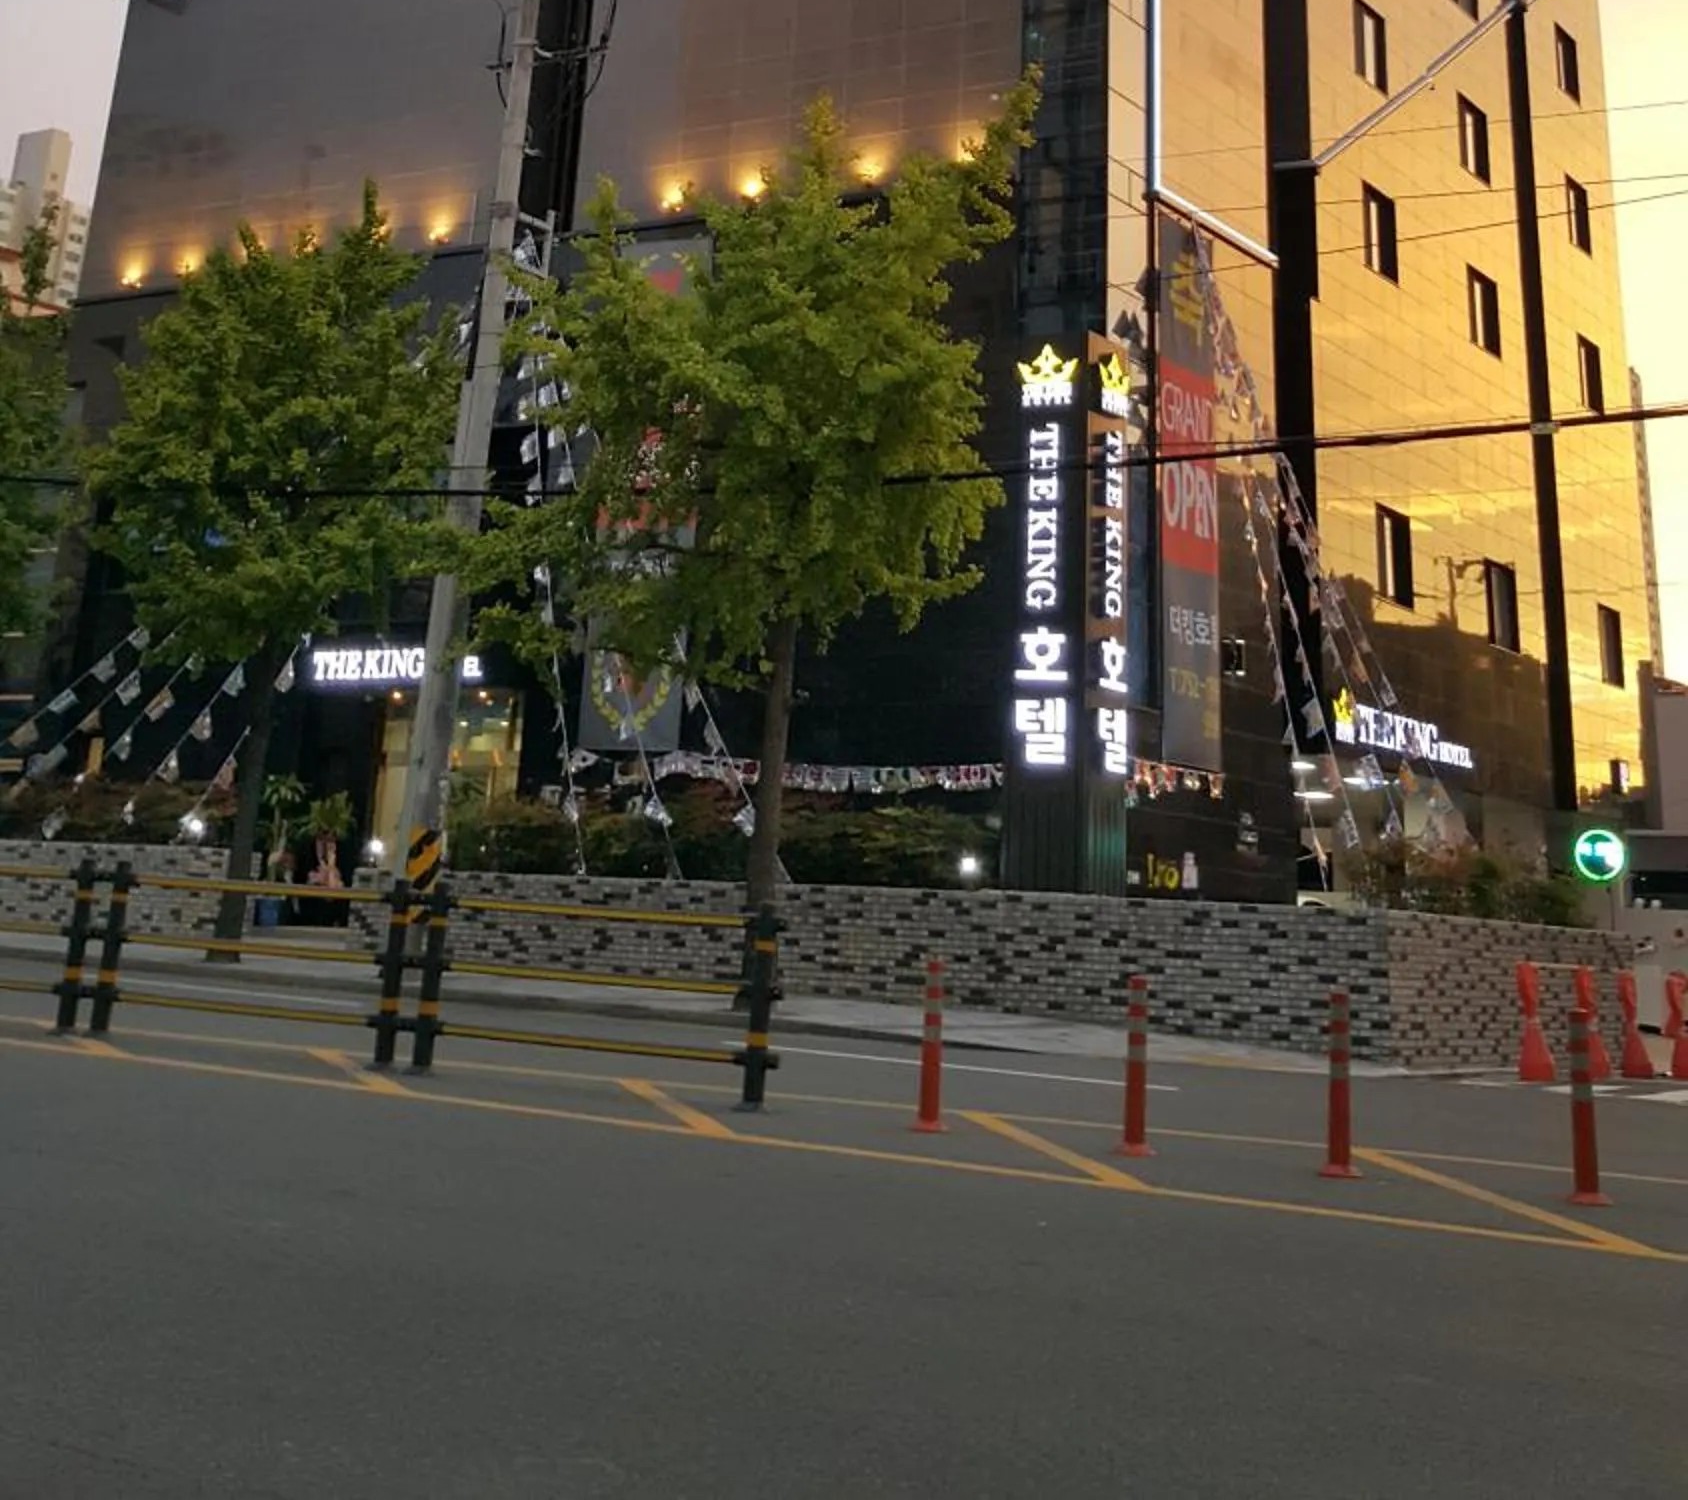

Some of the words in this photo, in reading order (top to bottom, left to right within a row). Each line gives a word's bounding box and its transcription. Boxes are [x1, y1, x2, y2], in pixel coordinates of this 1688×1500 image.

[1161, 381, 1213, 443] GRAND
[1029, 422, 1060, 501] THE
[1104, 429, 1124, 510] THE
[1162, 460, 1218, 543] OPEN
[1026, 507, 1058, 610] KING
[1104, 515, 1124, 619] KING
[313, 650, 362, 681] THE
[362, 647, 425, 680] KING
[1014, 625, 1069, 766] 호텔
[1099, 635, 1128, 775] 호텔
